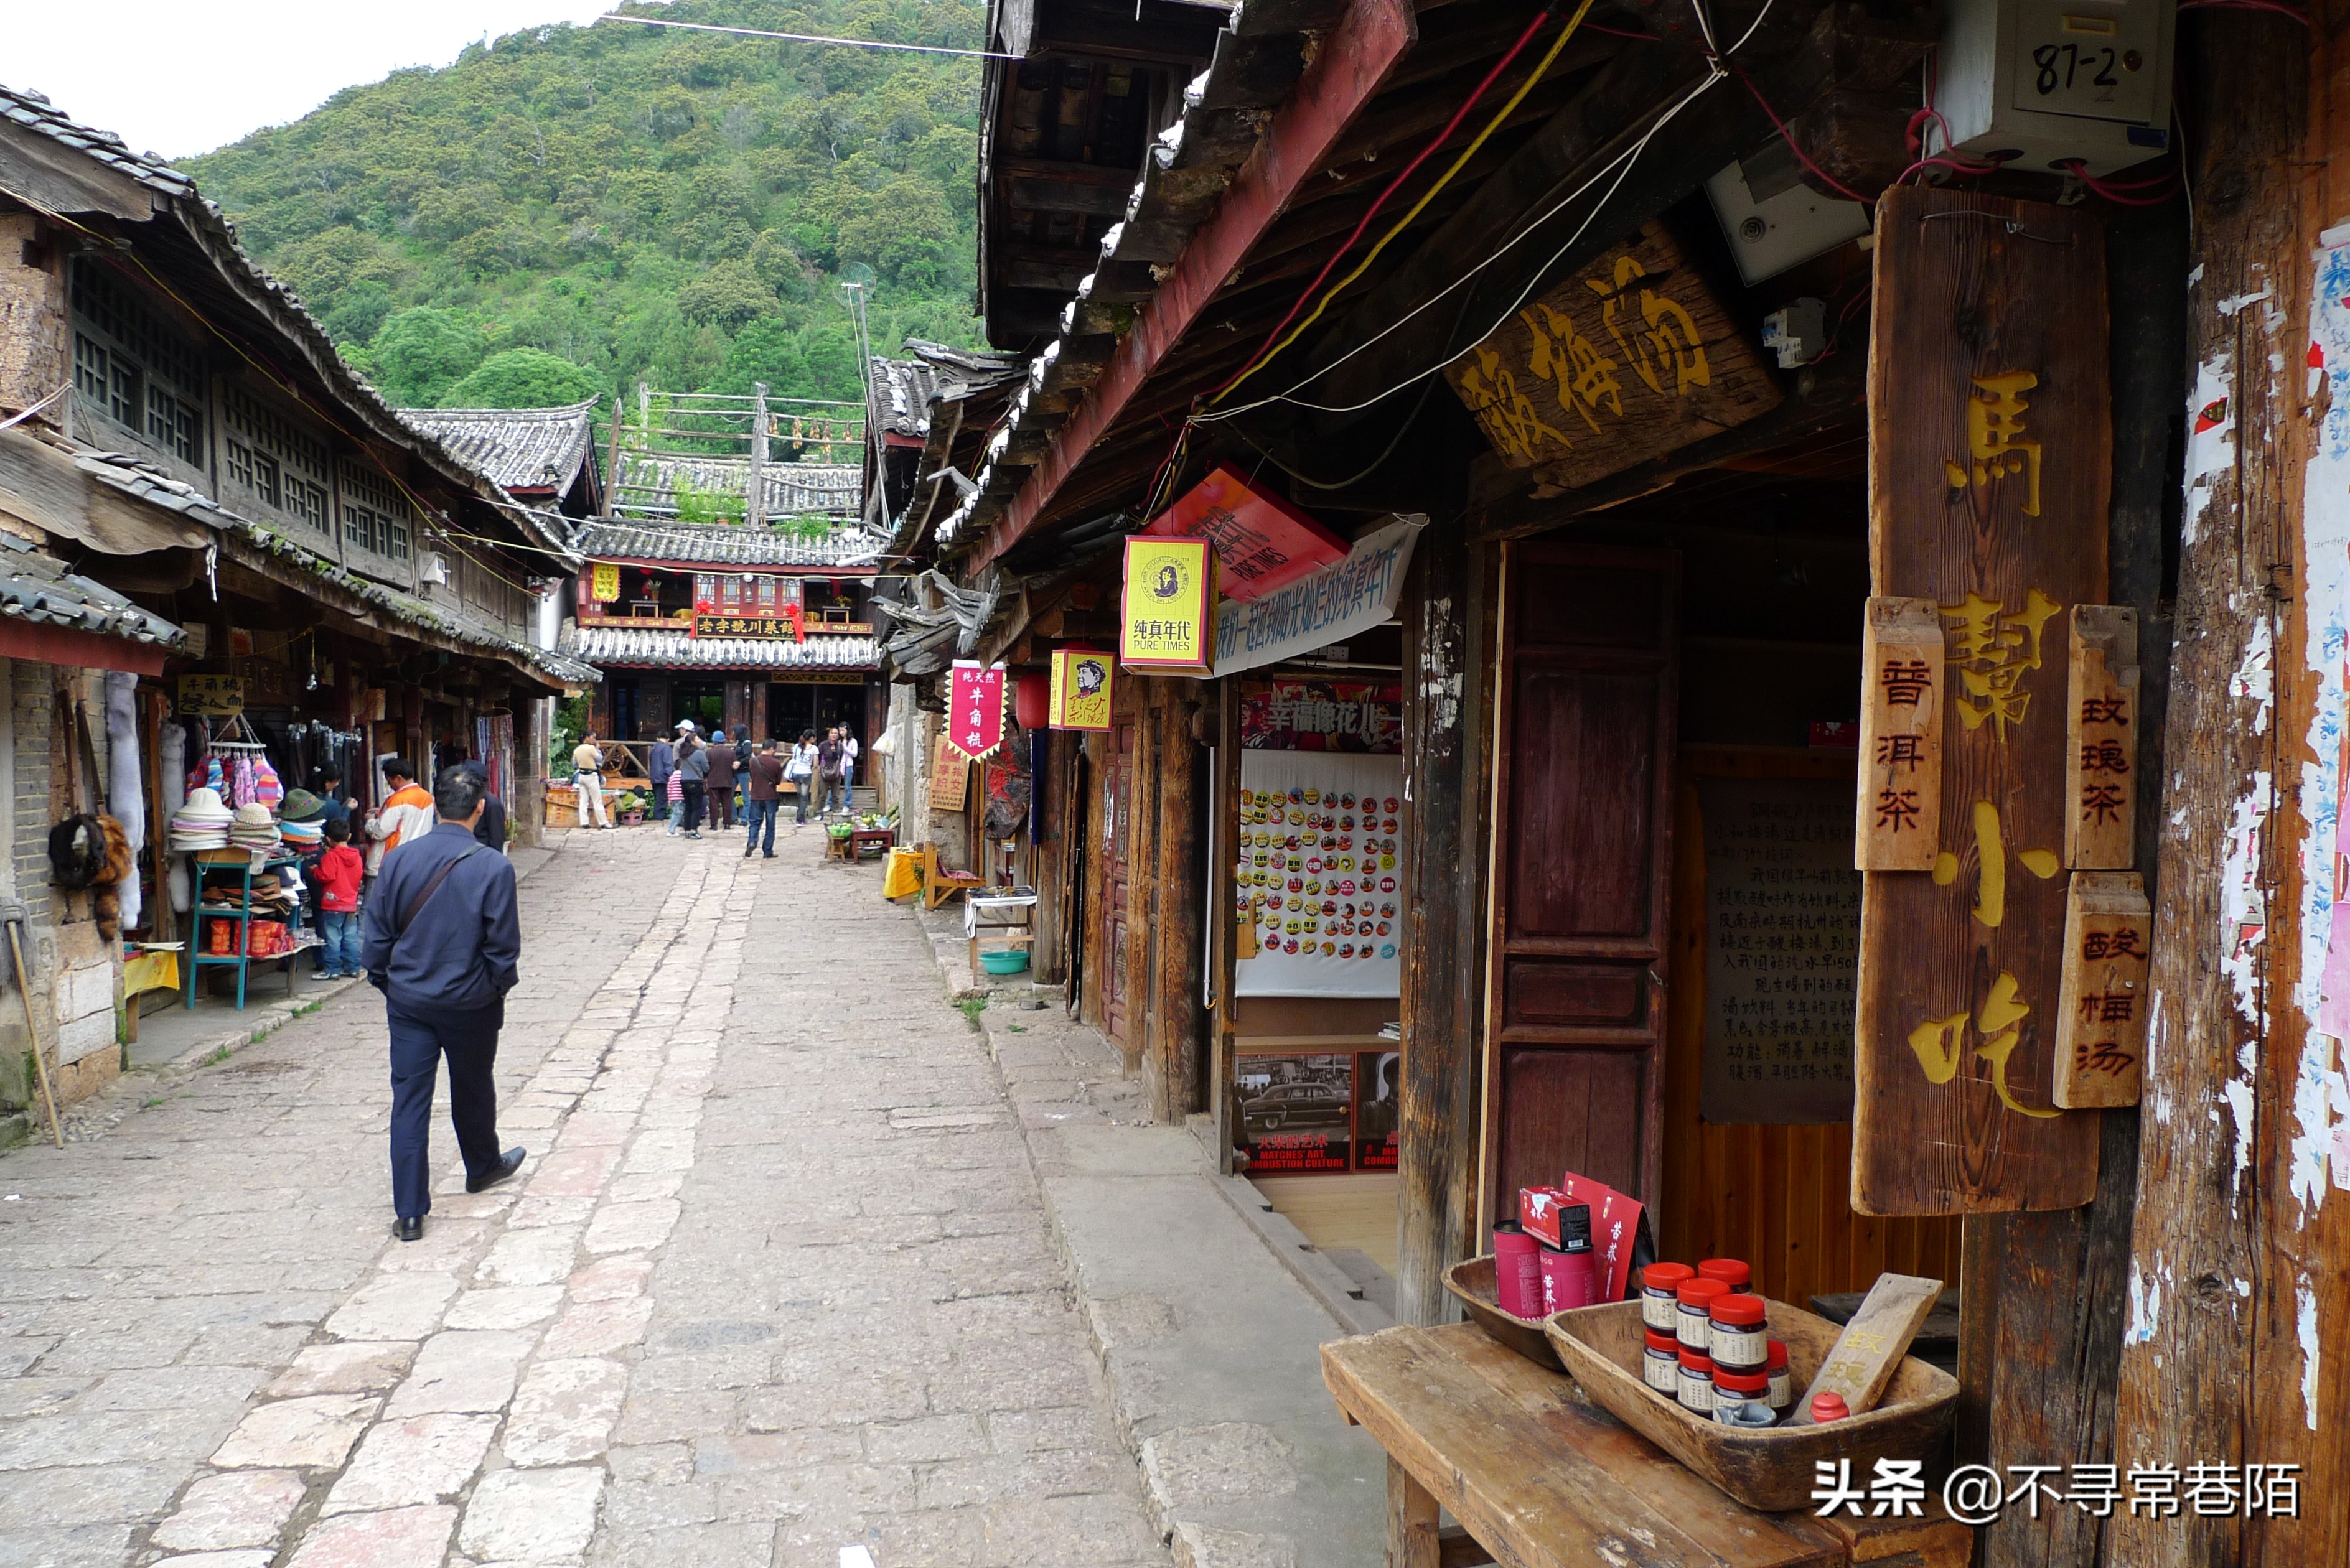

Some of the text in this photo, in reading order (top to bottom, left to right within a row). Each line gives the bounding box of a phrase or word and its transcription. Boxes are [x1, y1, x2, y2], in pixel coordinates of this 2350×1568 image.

[2032, 44, 2118, 95] 87-2
[1229, 546, 1290, 582] PURE TIMES
[1133, 620, 1191, 640] 纯真年代
[1134, 640, 1189, 651] PURE TIMES
[962, 671, 995, 684] 纯天然
[965, 686, 984, 747] 牛角梳
[1268, 700, 1401, 734] 幸福像花儿一
[1876, 660, 1932, 831] 普洱茶
[2081, 696, 2130, 826] 玫瑰茶
[1307, 862, 1321, 870] 中国
[2076, 927, 2148, 1076] 酸梅汤
[1249, 1159, 1344, 1169] OMBUSTION CULTURE
